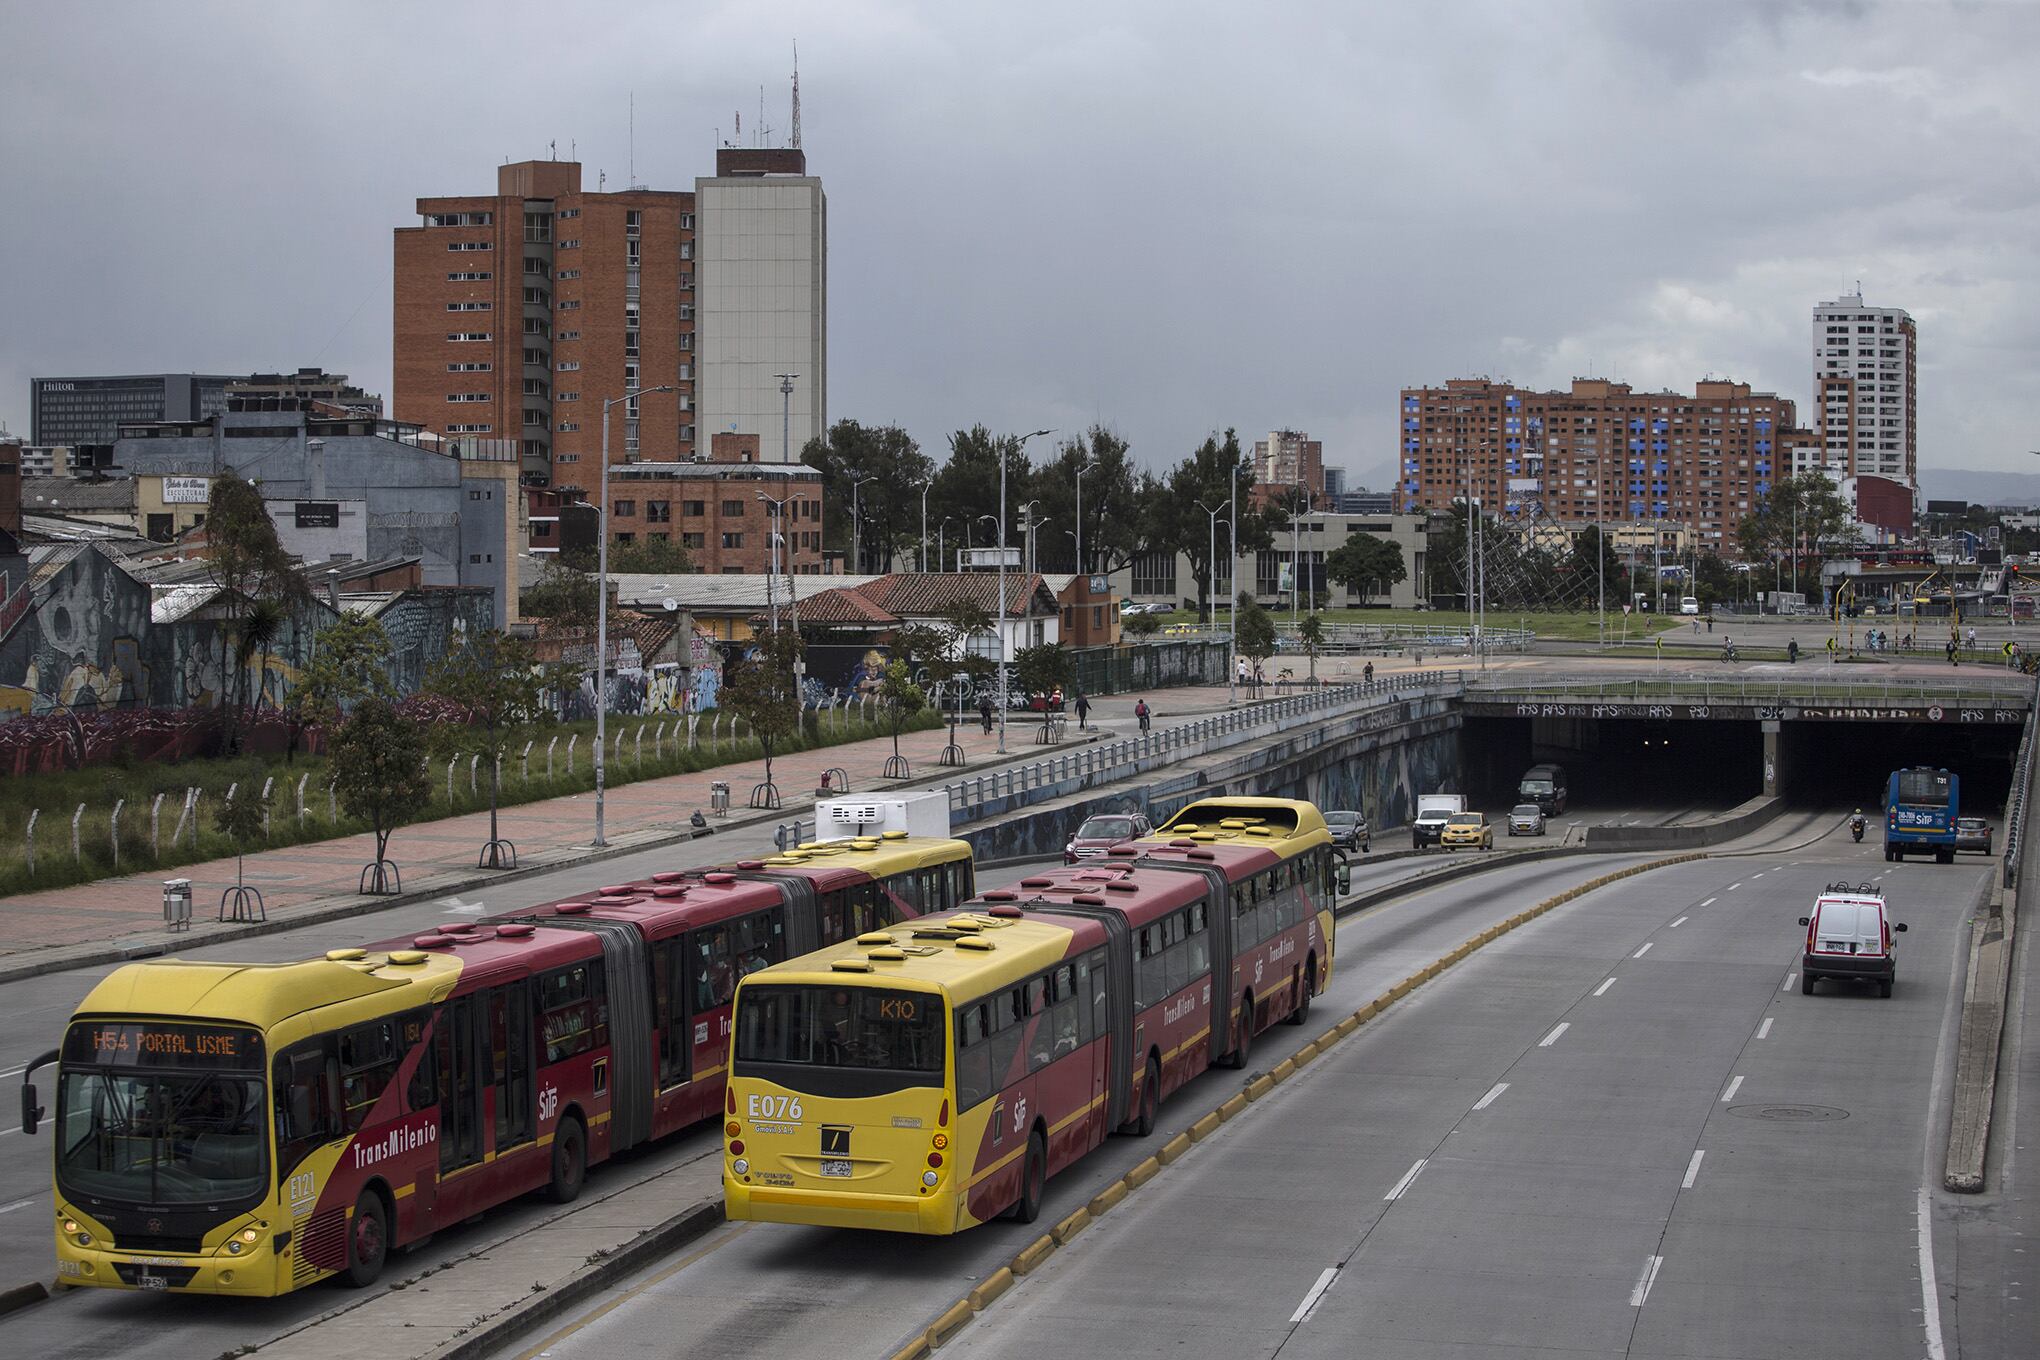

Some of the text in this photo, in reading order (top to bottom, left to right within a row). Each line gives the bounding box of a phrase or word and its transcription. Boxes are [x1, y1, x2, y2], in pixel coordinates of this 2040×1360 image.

[43, 381, 75, 391] Hilton
[1542, 703, 1566, 718] RAS
[1592, 704, 1618, 718] RAS
[1648, 705, 1673, 718] RAS
[1960, 709, 2020, 722] RAS RAS
[881, 999, 915, 1020] K10
[136, 1033, 193, 1054] PORTAL
[748, 1094, 804, 1119] E076
[353, 1120, 437, 1169] TransMilenio
